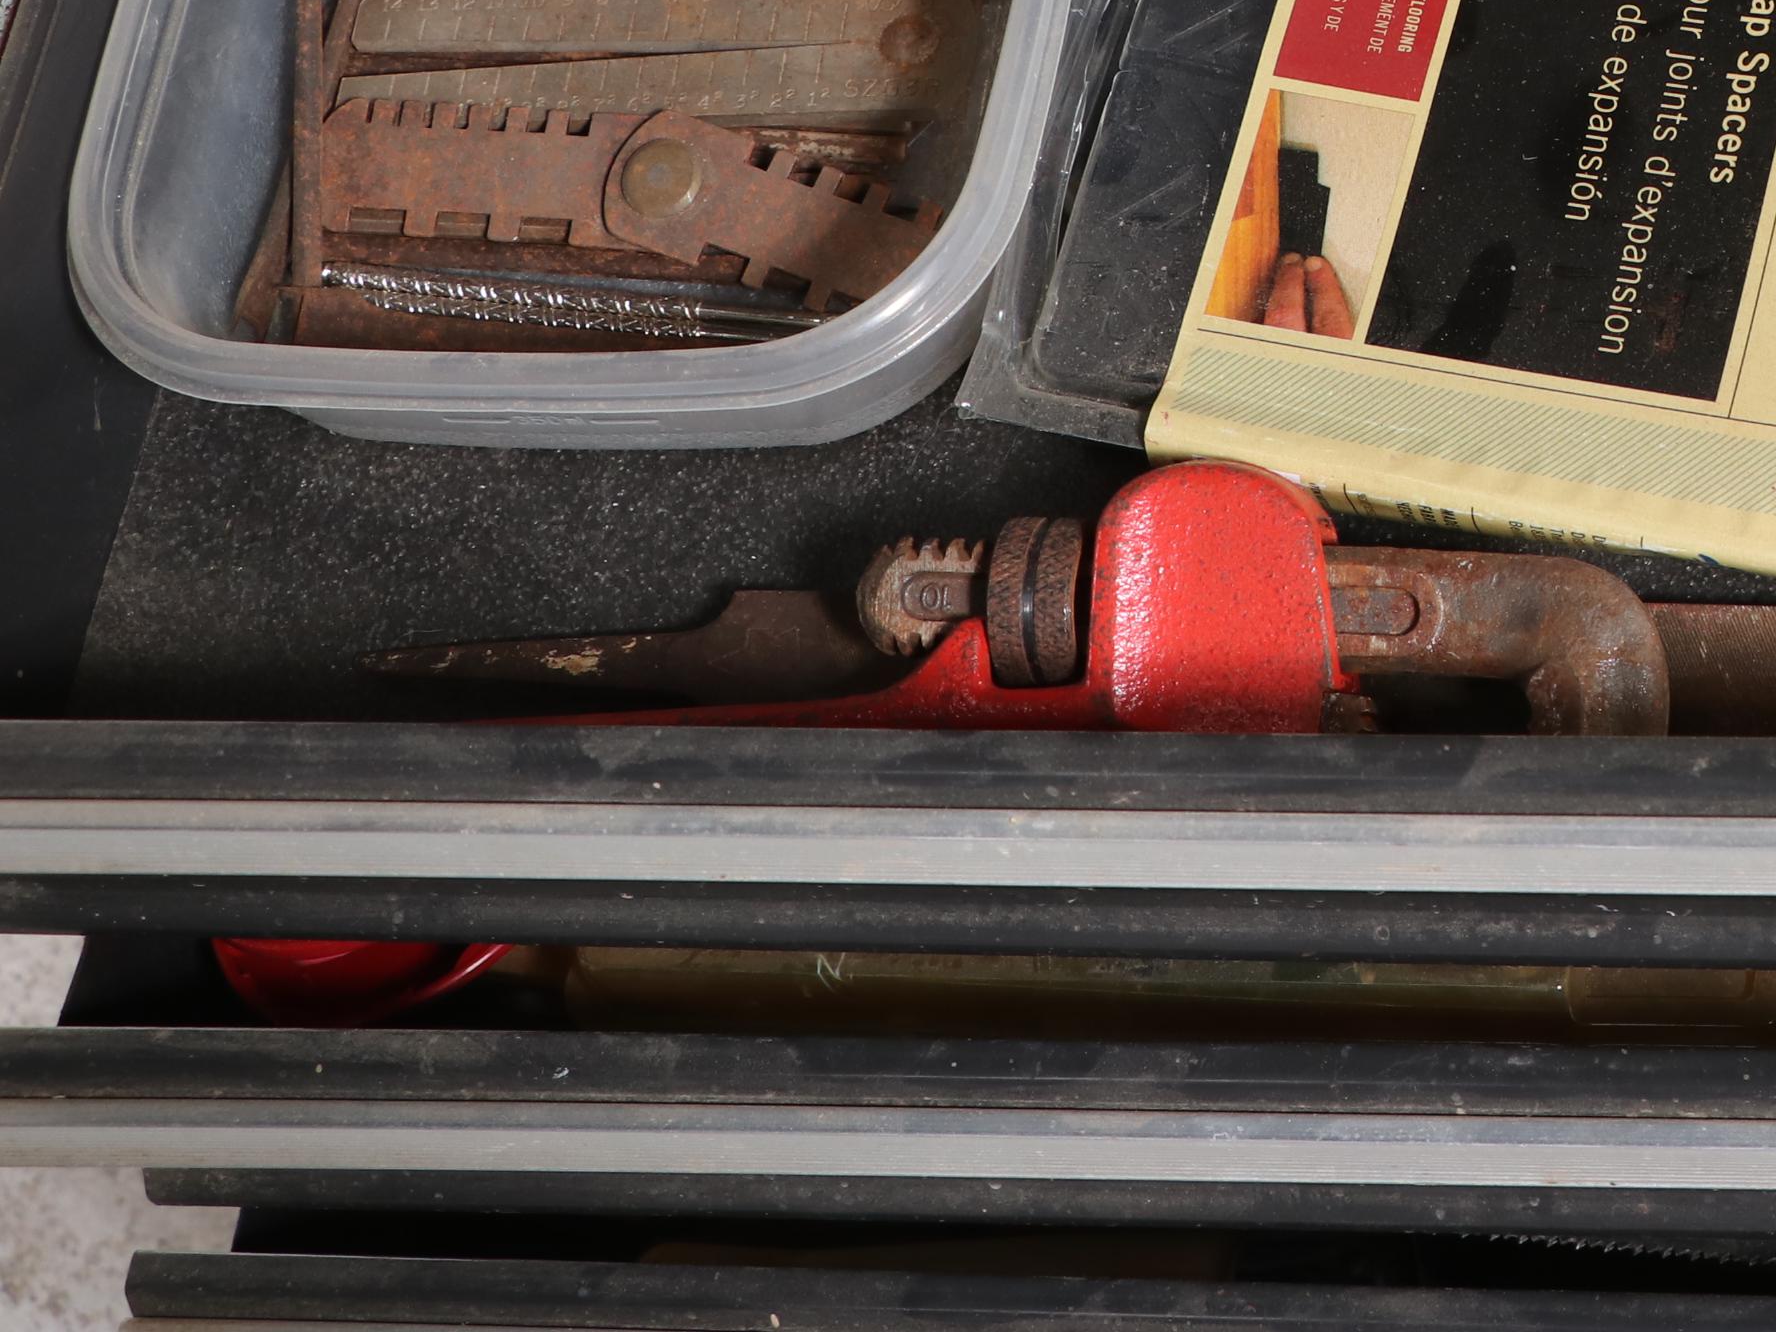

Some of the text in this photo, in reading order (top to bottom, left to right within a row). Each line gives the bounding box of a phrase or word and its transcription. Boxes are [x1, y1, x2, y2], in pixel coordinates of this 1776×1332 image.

[383, 0, 402, 12] 14
[1323, 15, 1341, 31] DE
[1611, 4, 1646, 42] de
[1367, 37, 1384, 53] DE
[1652, 49, 1704, 140] joints
[1709, 51, 1769, 182] Spacers
[1564, 56, 1627, 220] expansión
[1597, 156, 1675, 353] d'expansion
[920, 582, 952, 611] 10
